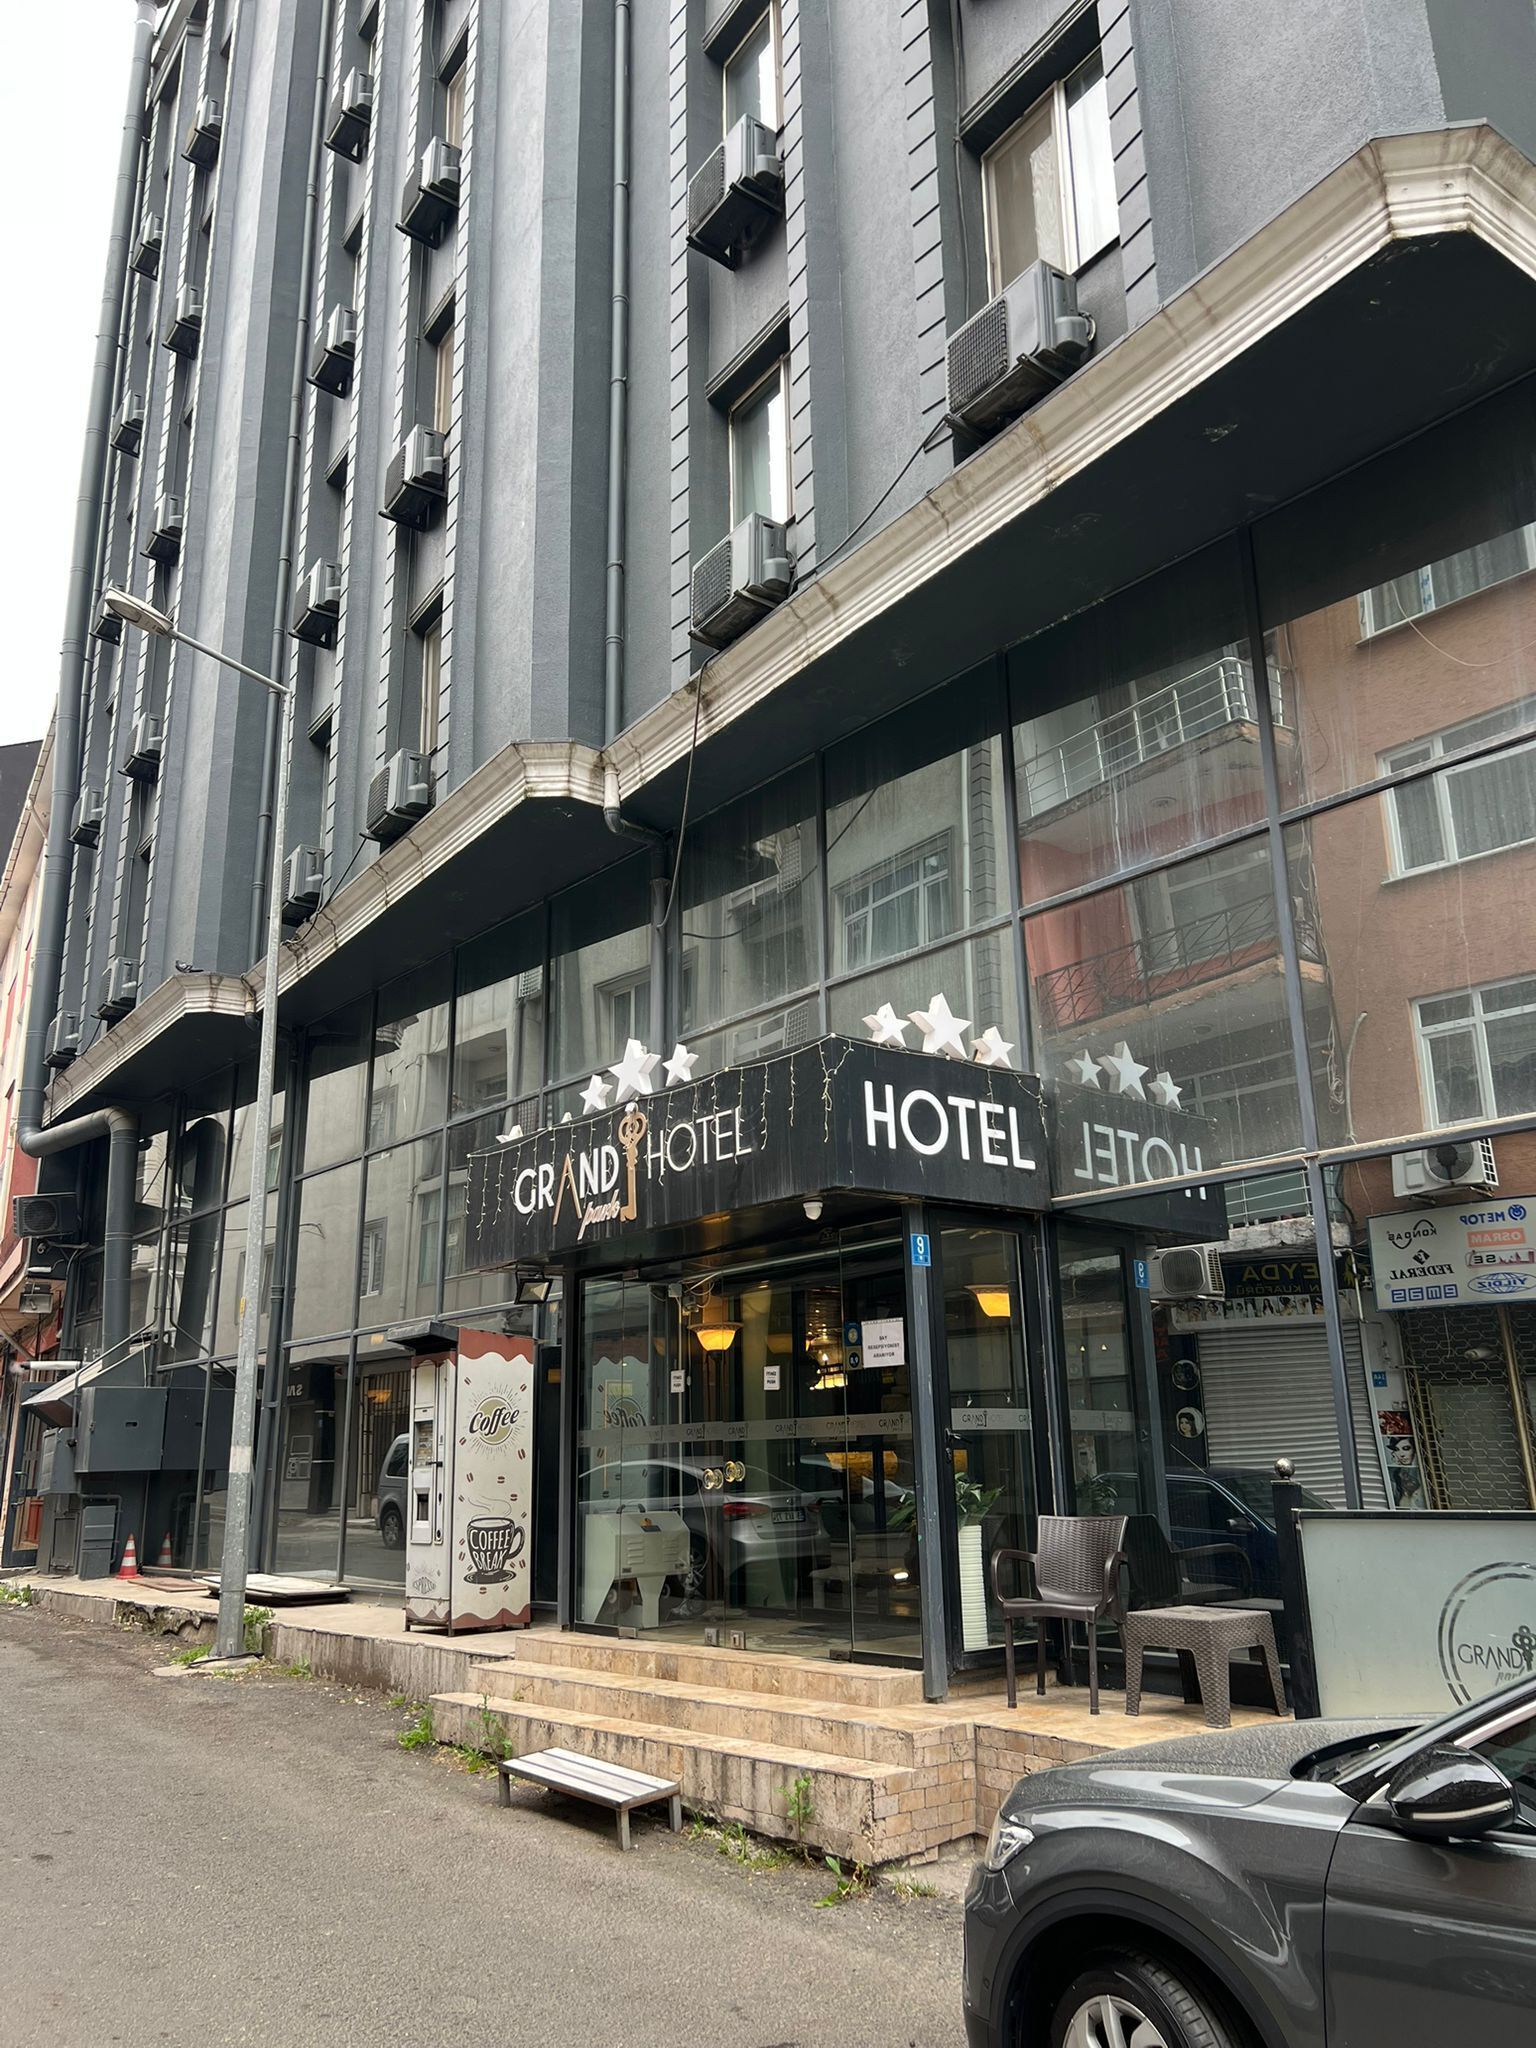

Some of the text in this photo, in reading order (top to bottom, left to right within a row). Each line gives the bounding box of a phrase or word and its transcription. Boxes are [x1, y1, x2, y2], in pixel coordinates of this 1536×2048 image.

[863, 1080, 1037, 1170] HOTEL
[514, 1106, 752, 1226] GRAND HOTEL
[916, 1236, 925, 1255] 9
[468, 1406, 520, 1437] Coffee
[469, 1528, 511, 1550] COFFEE
[472, 1549, 508, 1571] BREAK
[1457, 1643, 1523, 1671] GRAND
